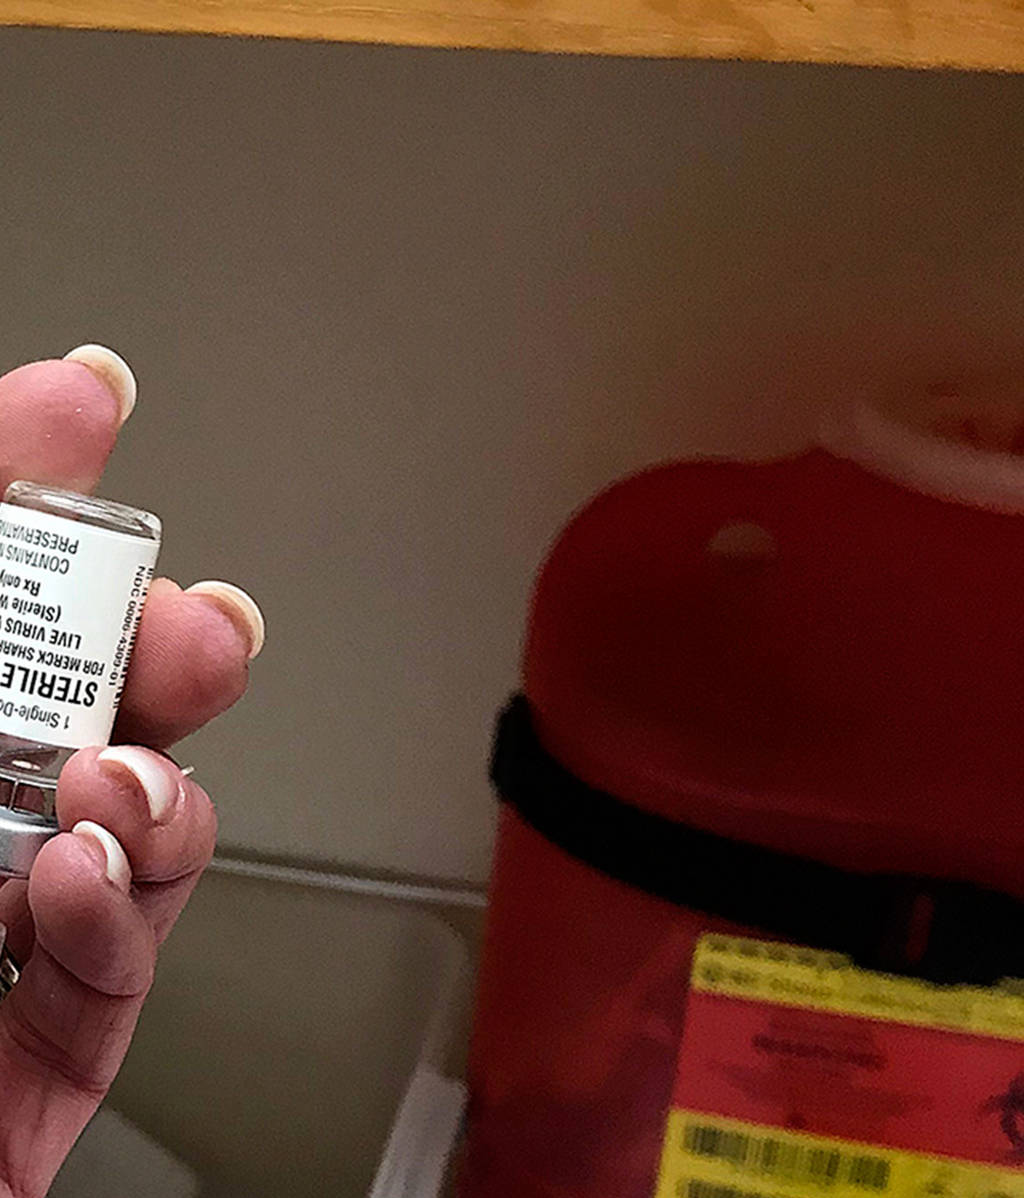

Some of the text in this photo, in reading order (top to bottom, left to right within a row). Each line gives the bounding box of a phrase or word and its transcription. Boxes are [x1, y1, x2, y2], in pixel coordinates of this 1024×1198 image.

[6, 544, 70, 575] CONTAINS
[23, 578, 41, 597] Rx
[130, 565, 146, 597] NDC
[12, 599, 62, 623] (Sterile
[4, 618, 46, 643] VIRUS
[49, 629, 82, 650] LIVE
[36, 648, 81, 672] MERCK
[83, 660, 105, 677] FOR
[0, 662, 99, 708] STERILE
[63, 715, 71, 730] 1
